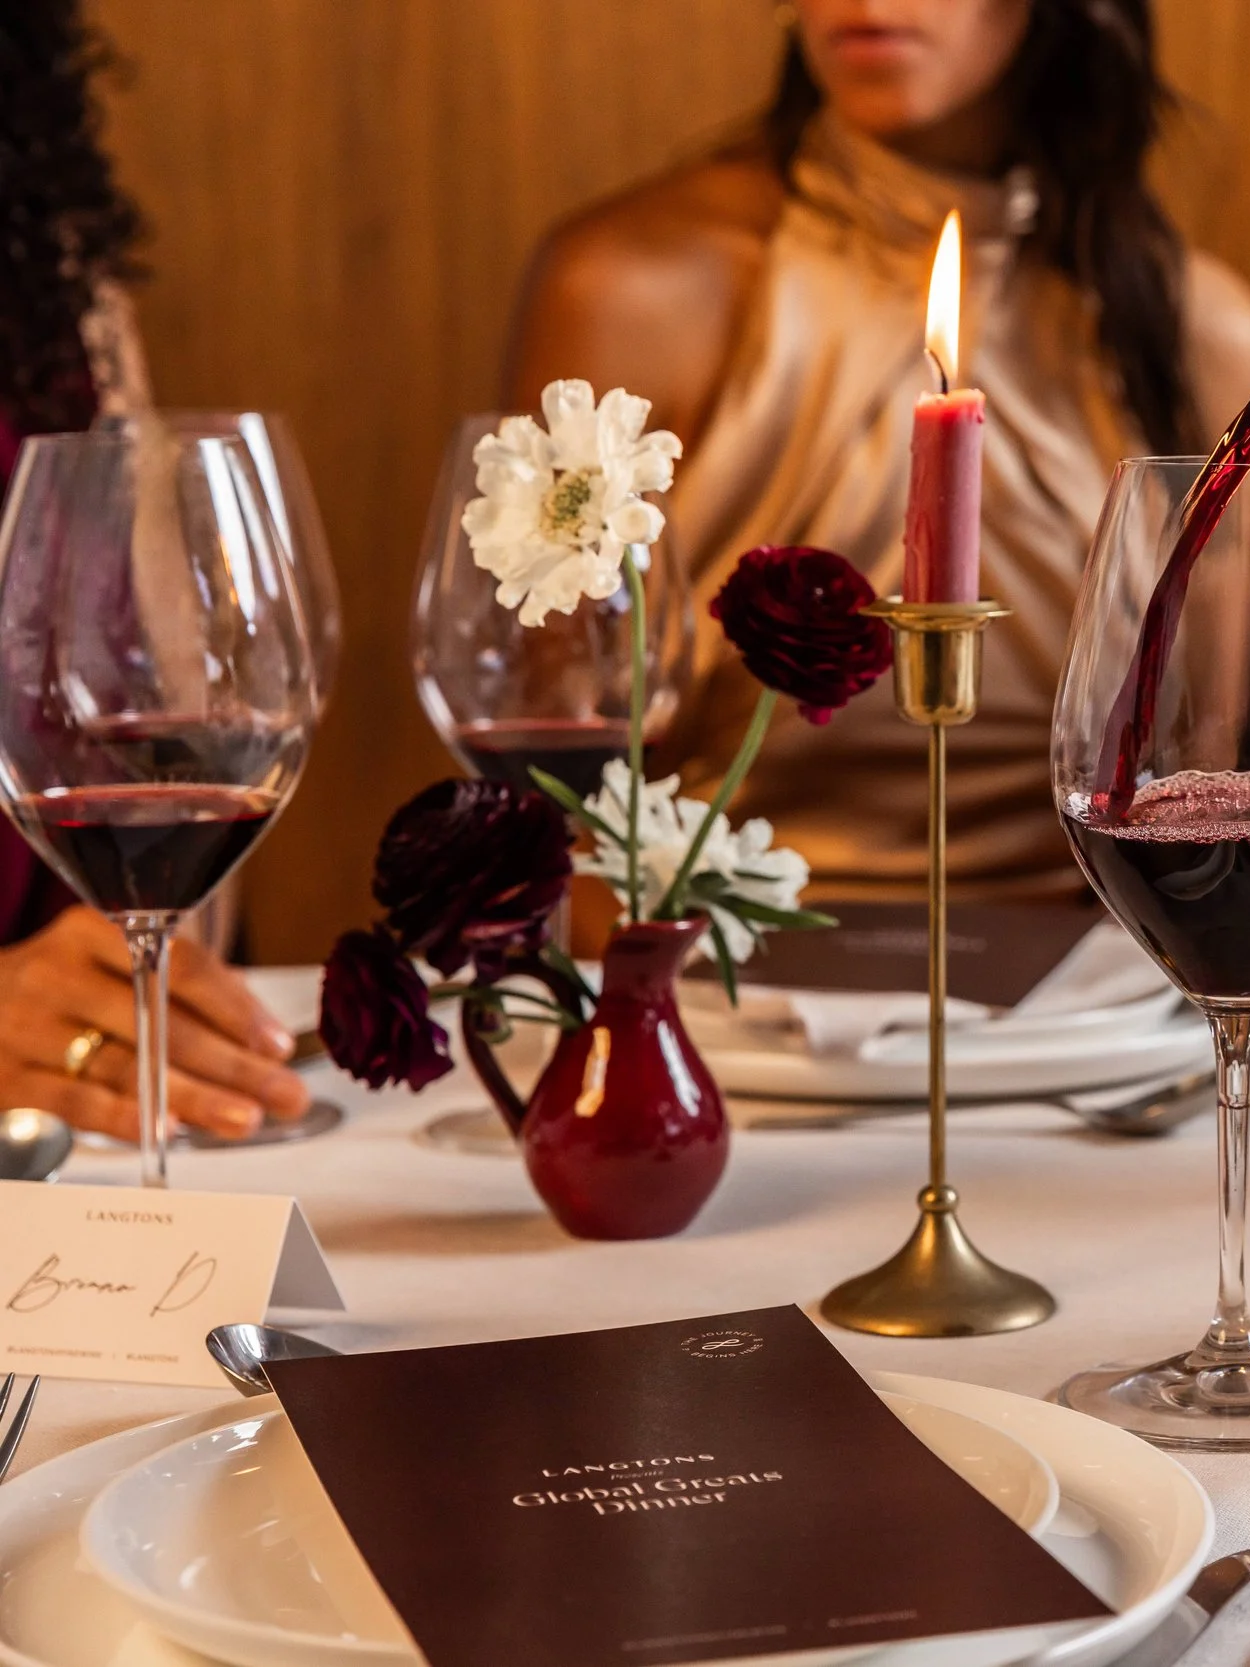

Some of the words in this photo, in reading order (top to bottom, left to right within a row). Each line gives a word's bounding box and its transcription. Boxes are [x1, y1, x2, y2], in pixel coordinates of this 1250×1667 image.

[86, 1210, 174, 1226] LANGTONS
[149, 1251, 217, 1317] D
[690, 1351, 736, 1359] BEGINS
[541, 1454, 715, 1478] LANGTONS
[512, 1481, 645, 1507] Global
[654, 1471, 783, 1492] Greats
[592, 1491, 728, 1516] Dinner
